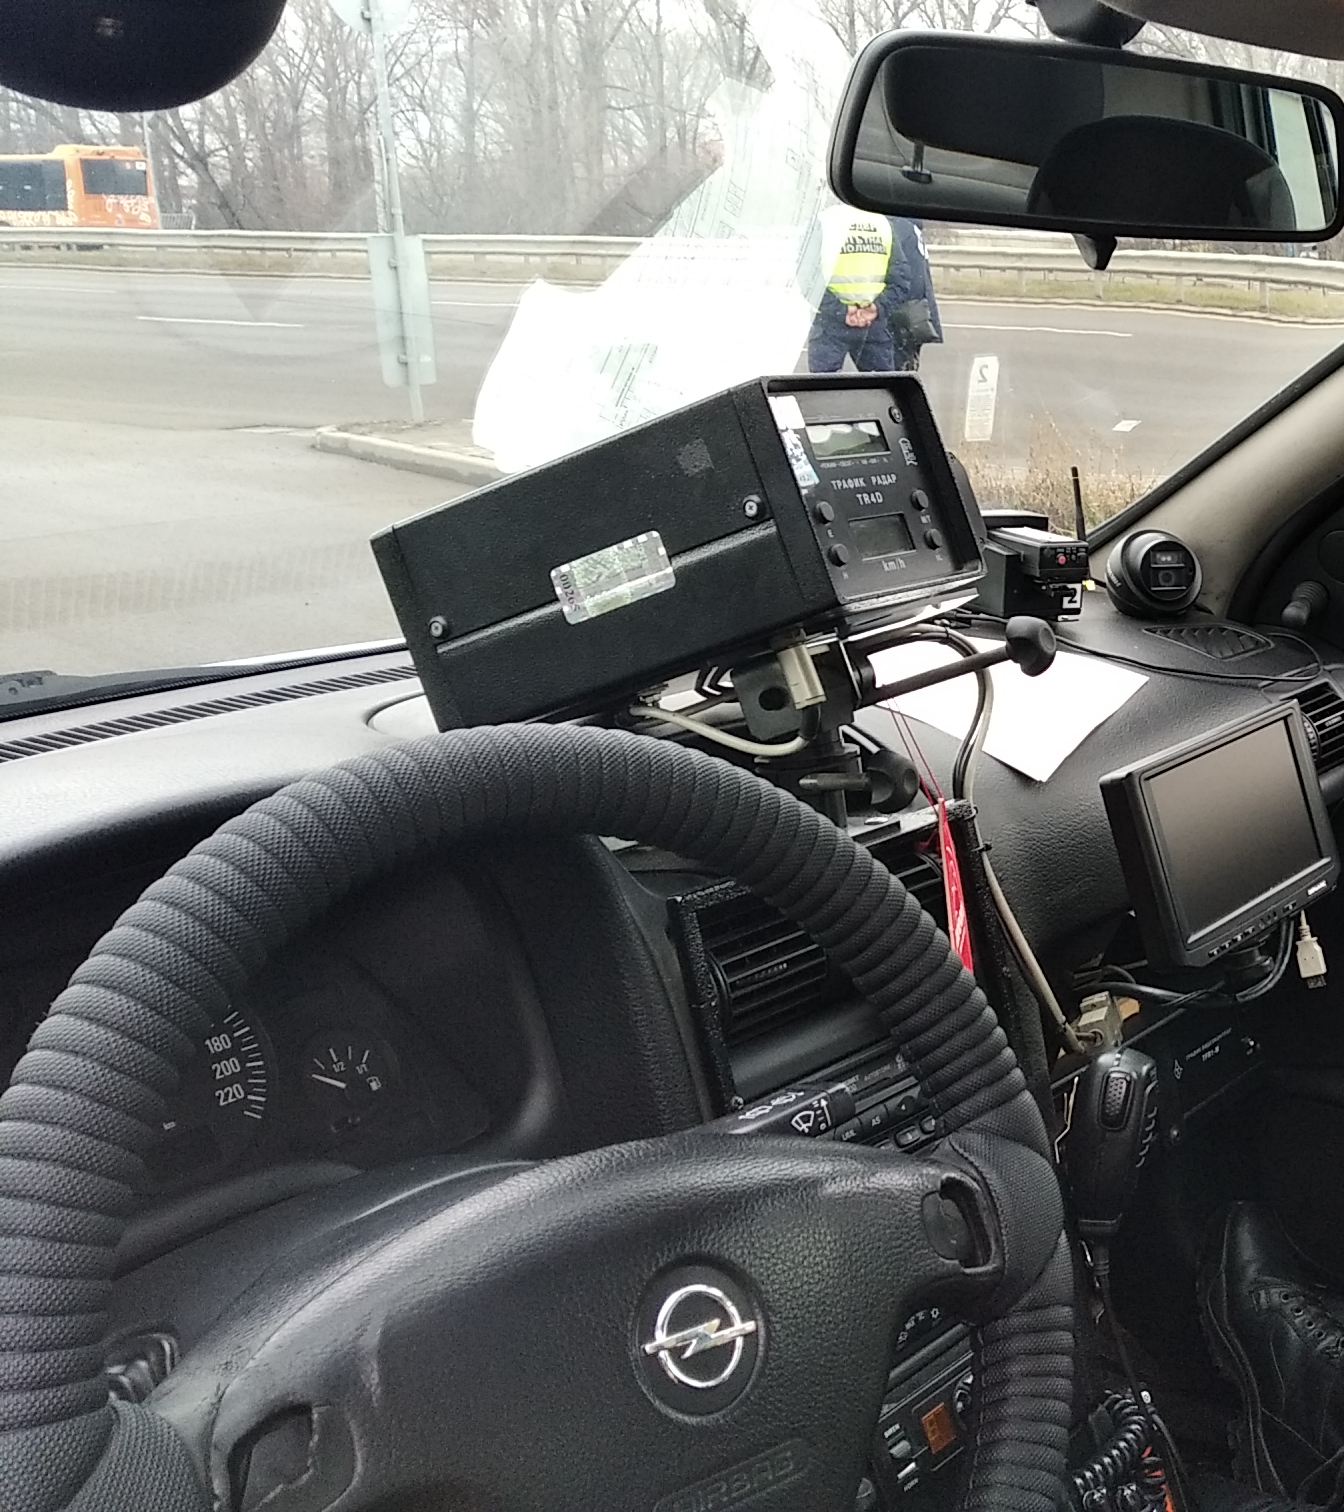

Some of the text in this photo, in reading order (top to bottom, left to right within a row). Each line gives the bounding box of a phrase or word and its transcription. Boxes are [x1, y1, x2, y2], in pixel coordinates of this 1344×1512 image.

[830, 473, 898, 490] ТРАФИК РАДАР
[855, 492, 885, 506] TR4D
[881, 558, 907, 572] km/h
[204, 1033, 231, 1054] 180
[211, 1057, 240, 1080] 200
[214, 1083, 245, 1107] 220
[871, 1115, 882, 1127] AS
